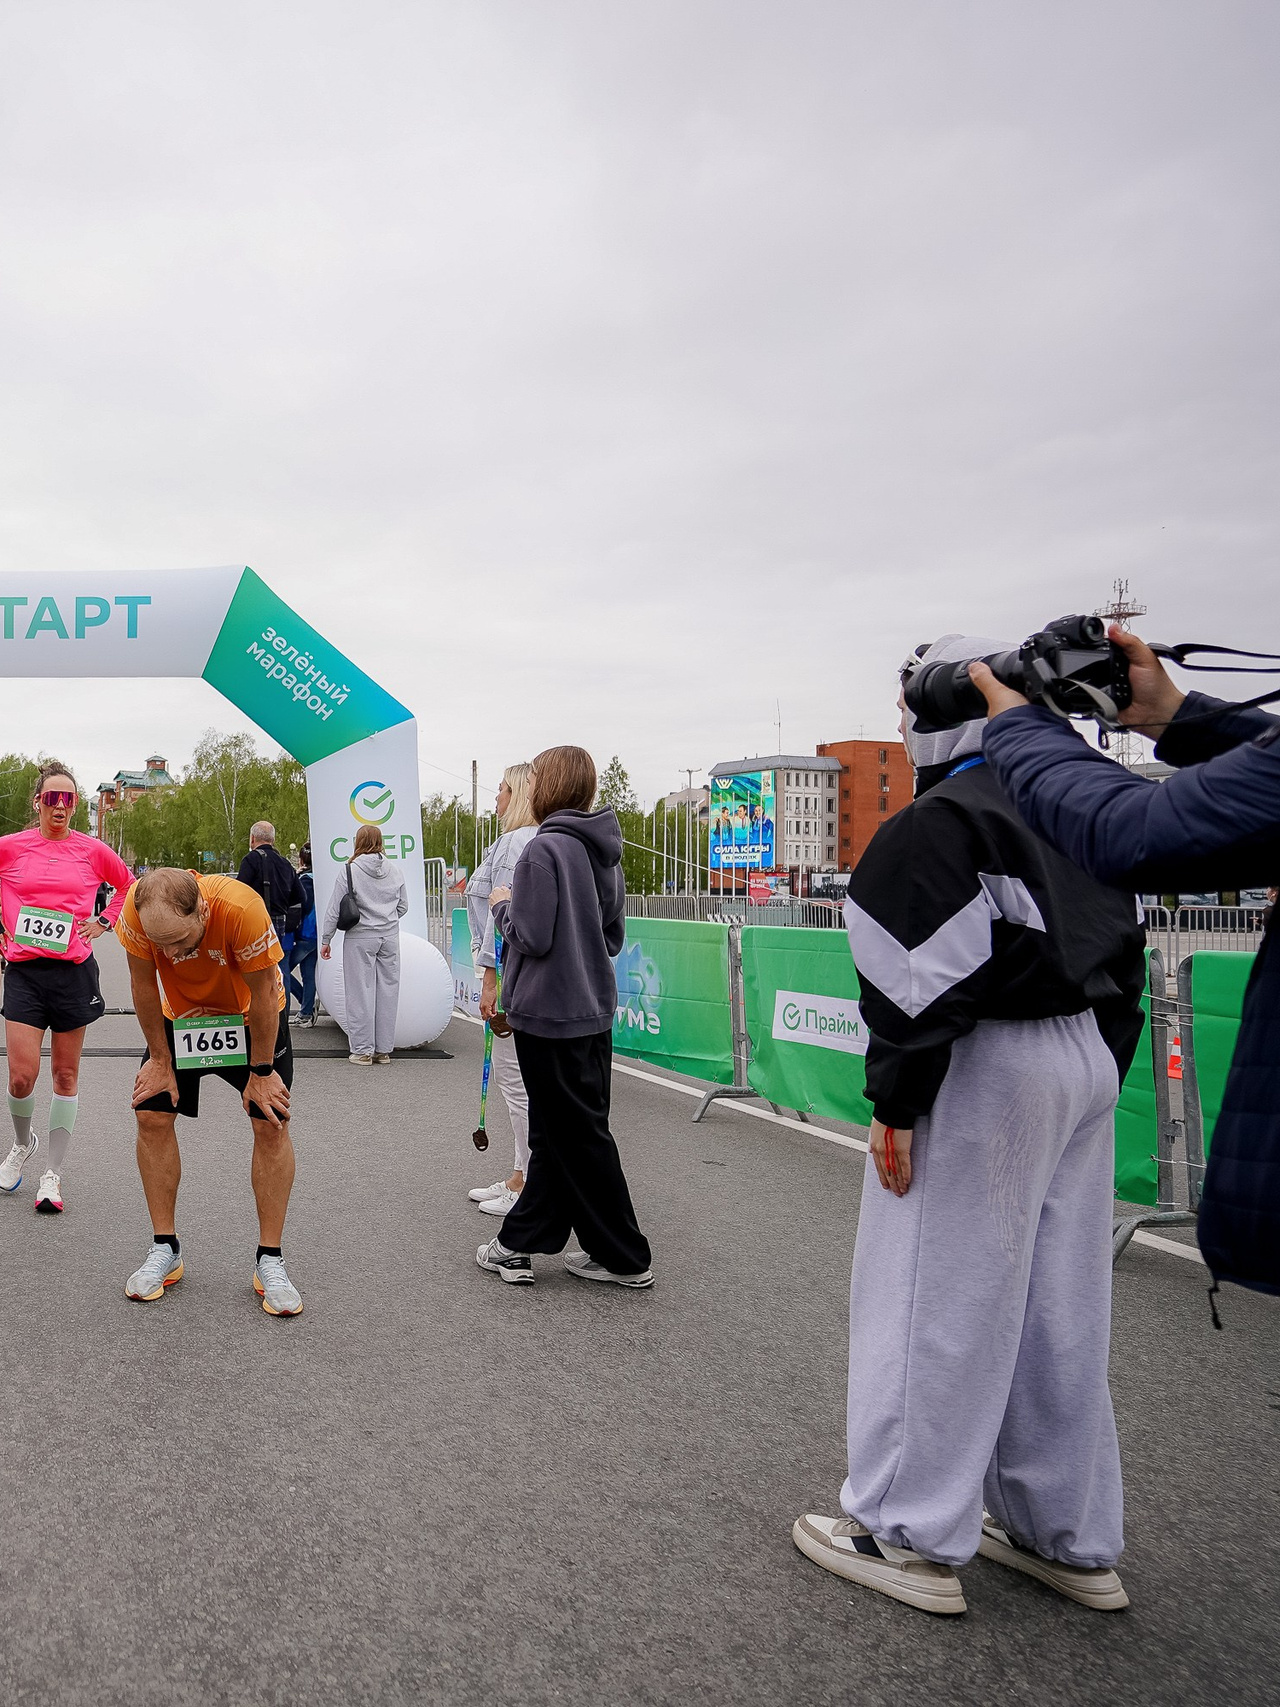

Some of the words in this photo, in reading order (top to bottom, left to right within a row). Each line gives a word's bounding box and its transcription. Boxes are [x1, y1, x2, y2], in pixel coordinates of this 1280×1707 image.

[261, 626, 351, 706] зелёный
[245, 641, 334, 721] марафон
[329, 834, 415, 862] СЕР
[23, 918, 66, 939] 1369
[805, 1008, 859, 1037] Прайм
[182, 1030, 238, 1053] 1665
[200, 1056, 223, 1066] 4,2км
